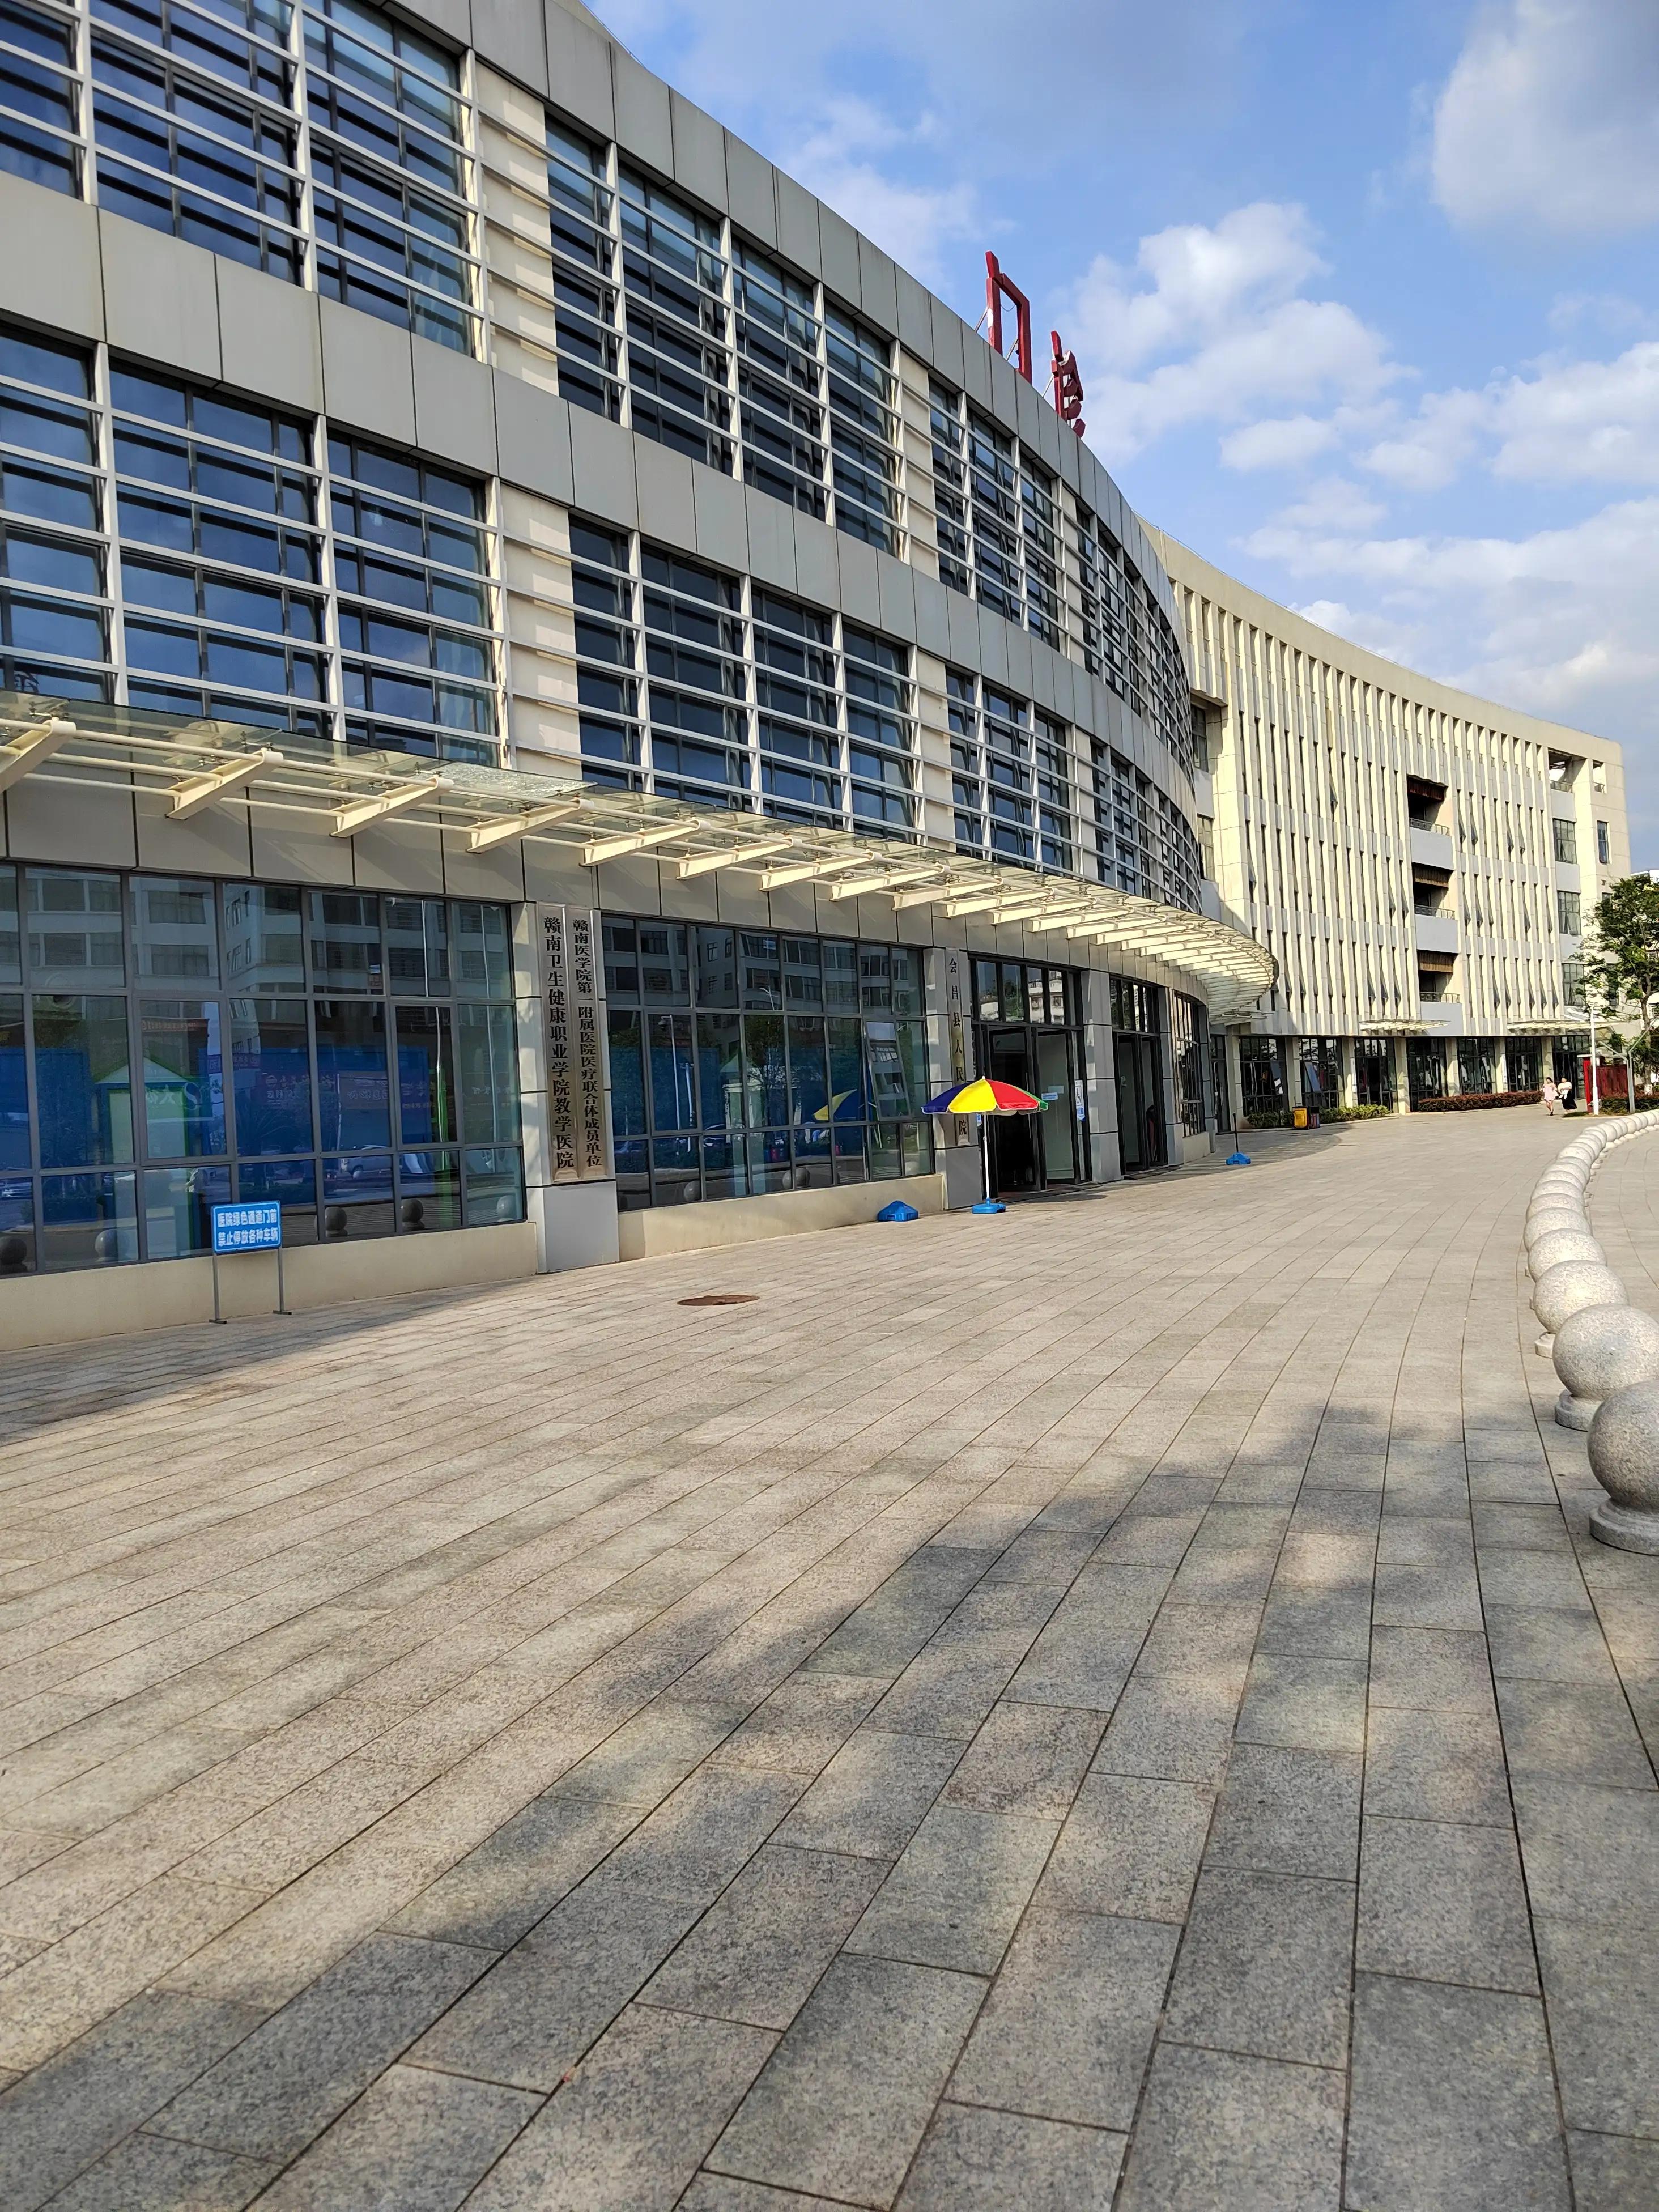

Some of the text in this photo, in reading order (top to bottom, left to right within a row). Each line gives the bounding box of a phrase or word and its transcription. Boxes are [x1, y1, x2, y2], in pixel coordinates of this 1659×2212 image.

[543, 916, 574, 1169] 赣南卫生健康职业学院教学医院
[573, 918, 602, 1167] 赣南医学院第一附属医院医疗联合体成员单位
[948, 958, 967, 1136] 会昌县人民院
[217, 1209, 278, 1228] 医院绿色通道门前
[218, 1227, 278, 1246] 禁止停放各种车辆
